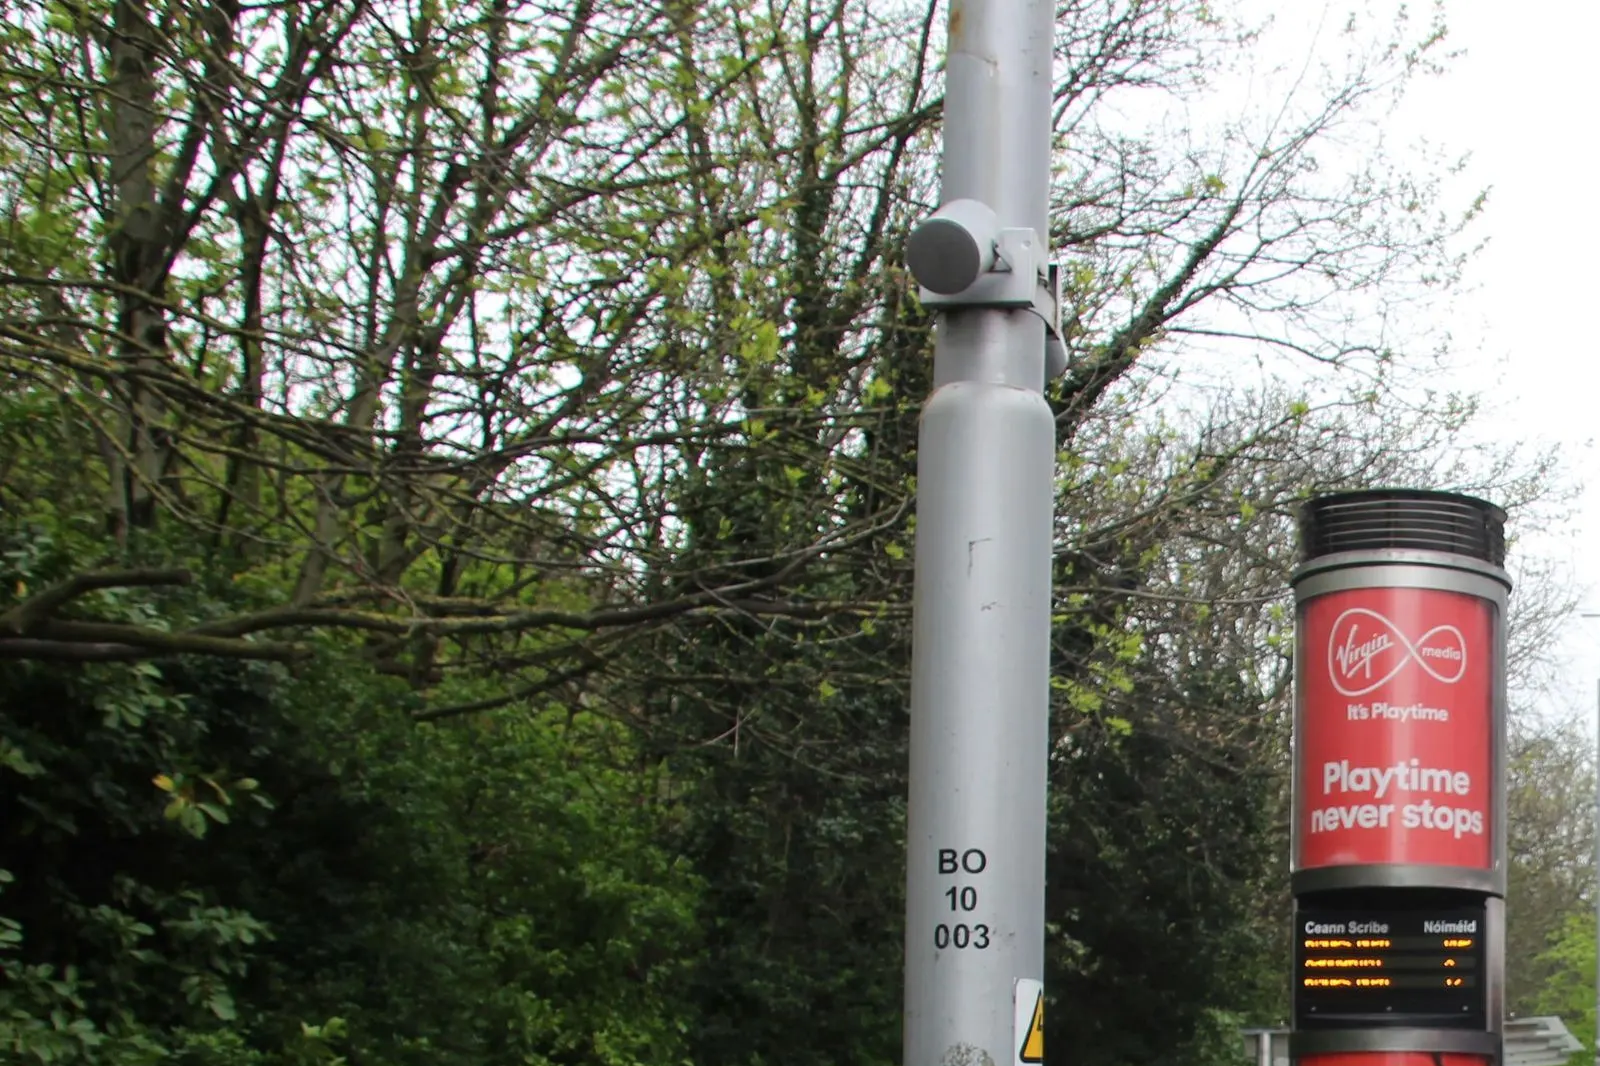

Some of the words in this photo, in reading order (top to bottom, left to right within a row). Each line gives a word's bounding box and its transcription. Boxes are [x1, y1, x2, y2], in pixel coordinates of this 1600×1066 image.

[1336, 623, 1394, 678] Virgin
[1422, 646, 1462, 661] media
[1347, 703, 1369, 721] It's
[1371, 702, 1449, 724] Playtime
[1323, 758, 1471, 798] Playtime
[1311, 803, 1396, 834] never
[1402, 799, 1483, 839] stops
[938, 849, 987, 875] BO
[945, 886, 978, 912] 10
[934, 923, 990, 949] 003
[1304, 921, 1345, 934] Ceann
[1348, 921, 1389, 934] Scribe
[1424, 919, 1477, 934] Nóiméid
